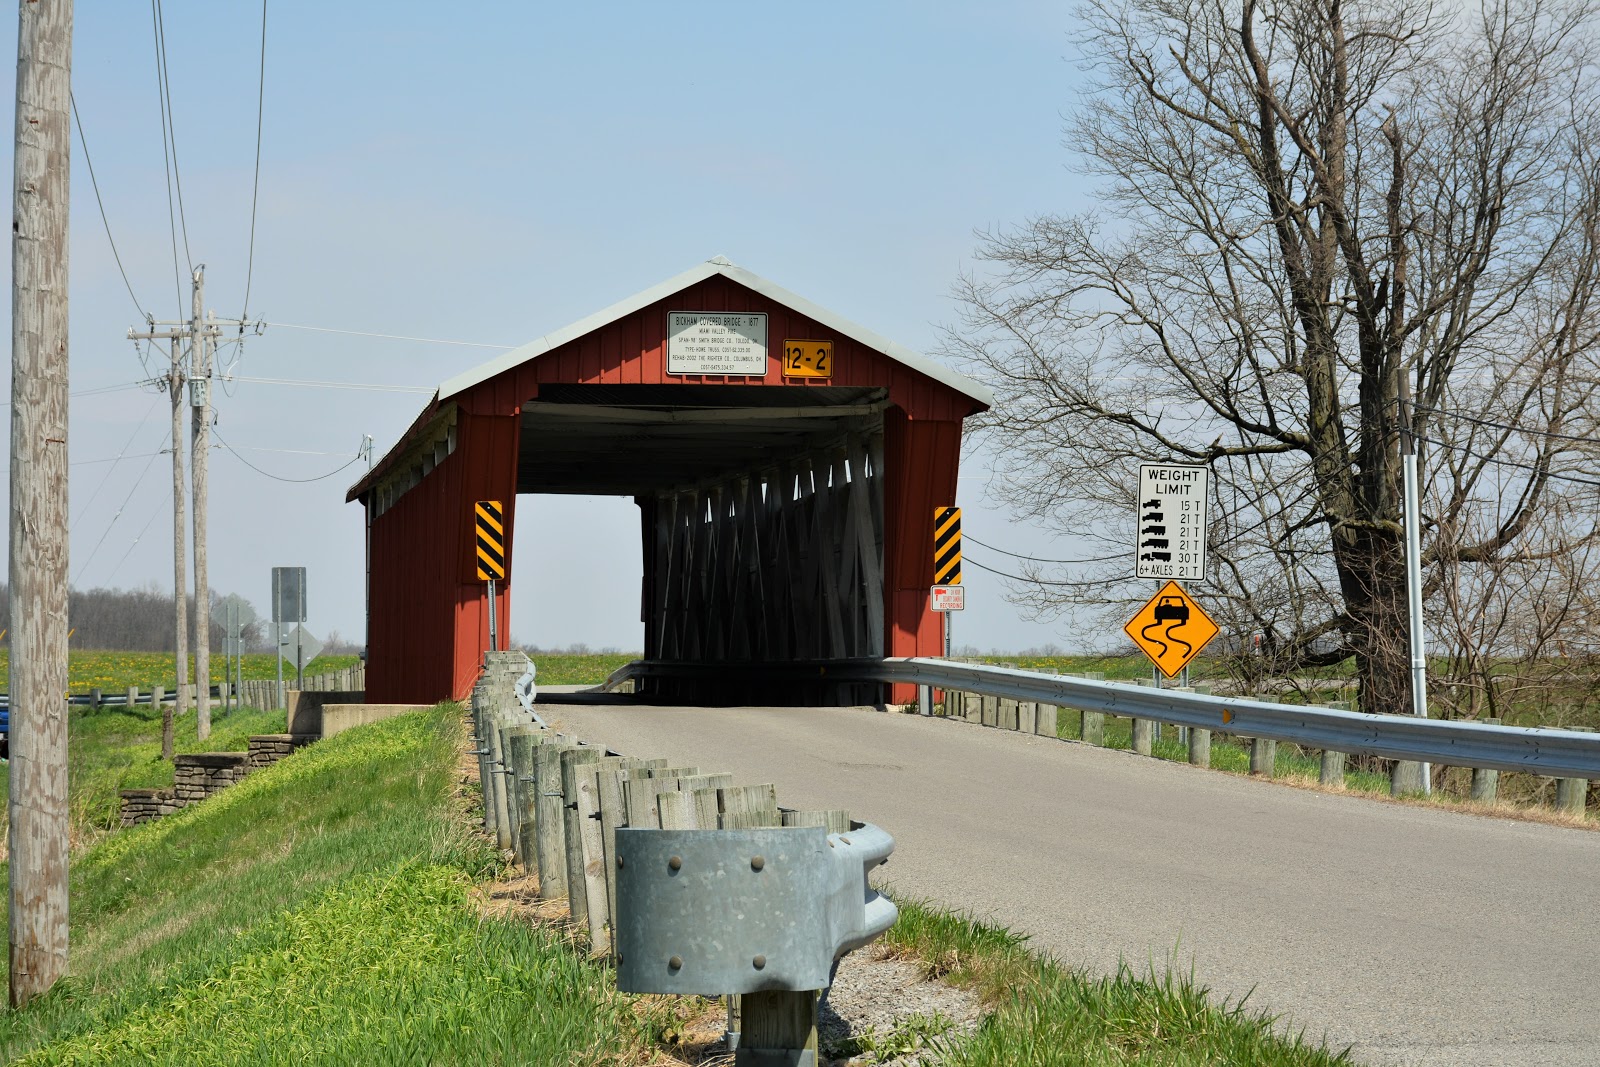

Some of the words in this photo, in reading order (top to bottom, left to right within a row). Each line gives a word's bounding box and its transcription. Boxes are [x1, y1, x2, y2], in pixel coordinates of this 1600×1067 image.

[676, 316, 697, 326] BICKHAM
[700, 317, 721, 326] COVERED
[724, 318, 741, 326] BRIDGE
[748, 318, 758, 326] 1877
[1148, 469, 1200, 482] WEIGHT
[1156, 484, 1191, 495] LIMIT
[1181, 501, 1190, 510] 15
[1195, 501, 1200, 511] T
[1180, 514, 1189, 524] 21
[1195, 514, 1200, 524] T
[1180, 527, 1189, 537] 21
[1194, 527, 1199, 537] T
[1180, 540, 1189, 550] 21
[1194, 540, 1199, 550] T
[1178, 553, 1190, 563] 30
[1193, 553, 1198, 563] T
[1139, 565, 1149, 574] 6+
[1151, 565, 1173, 576] AXLES
[1179, 566, 1188, 576] 21
[1193, 567, 1198, 576] T
